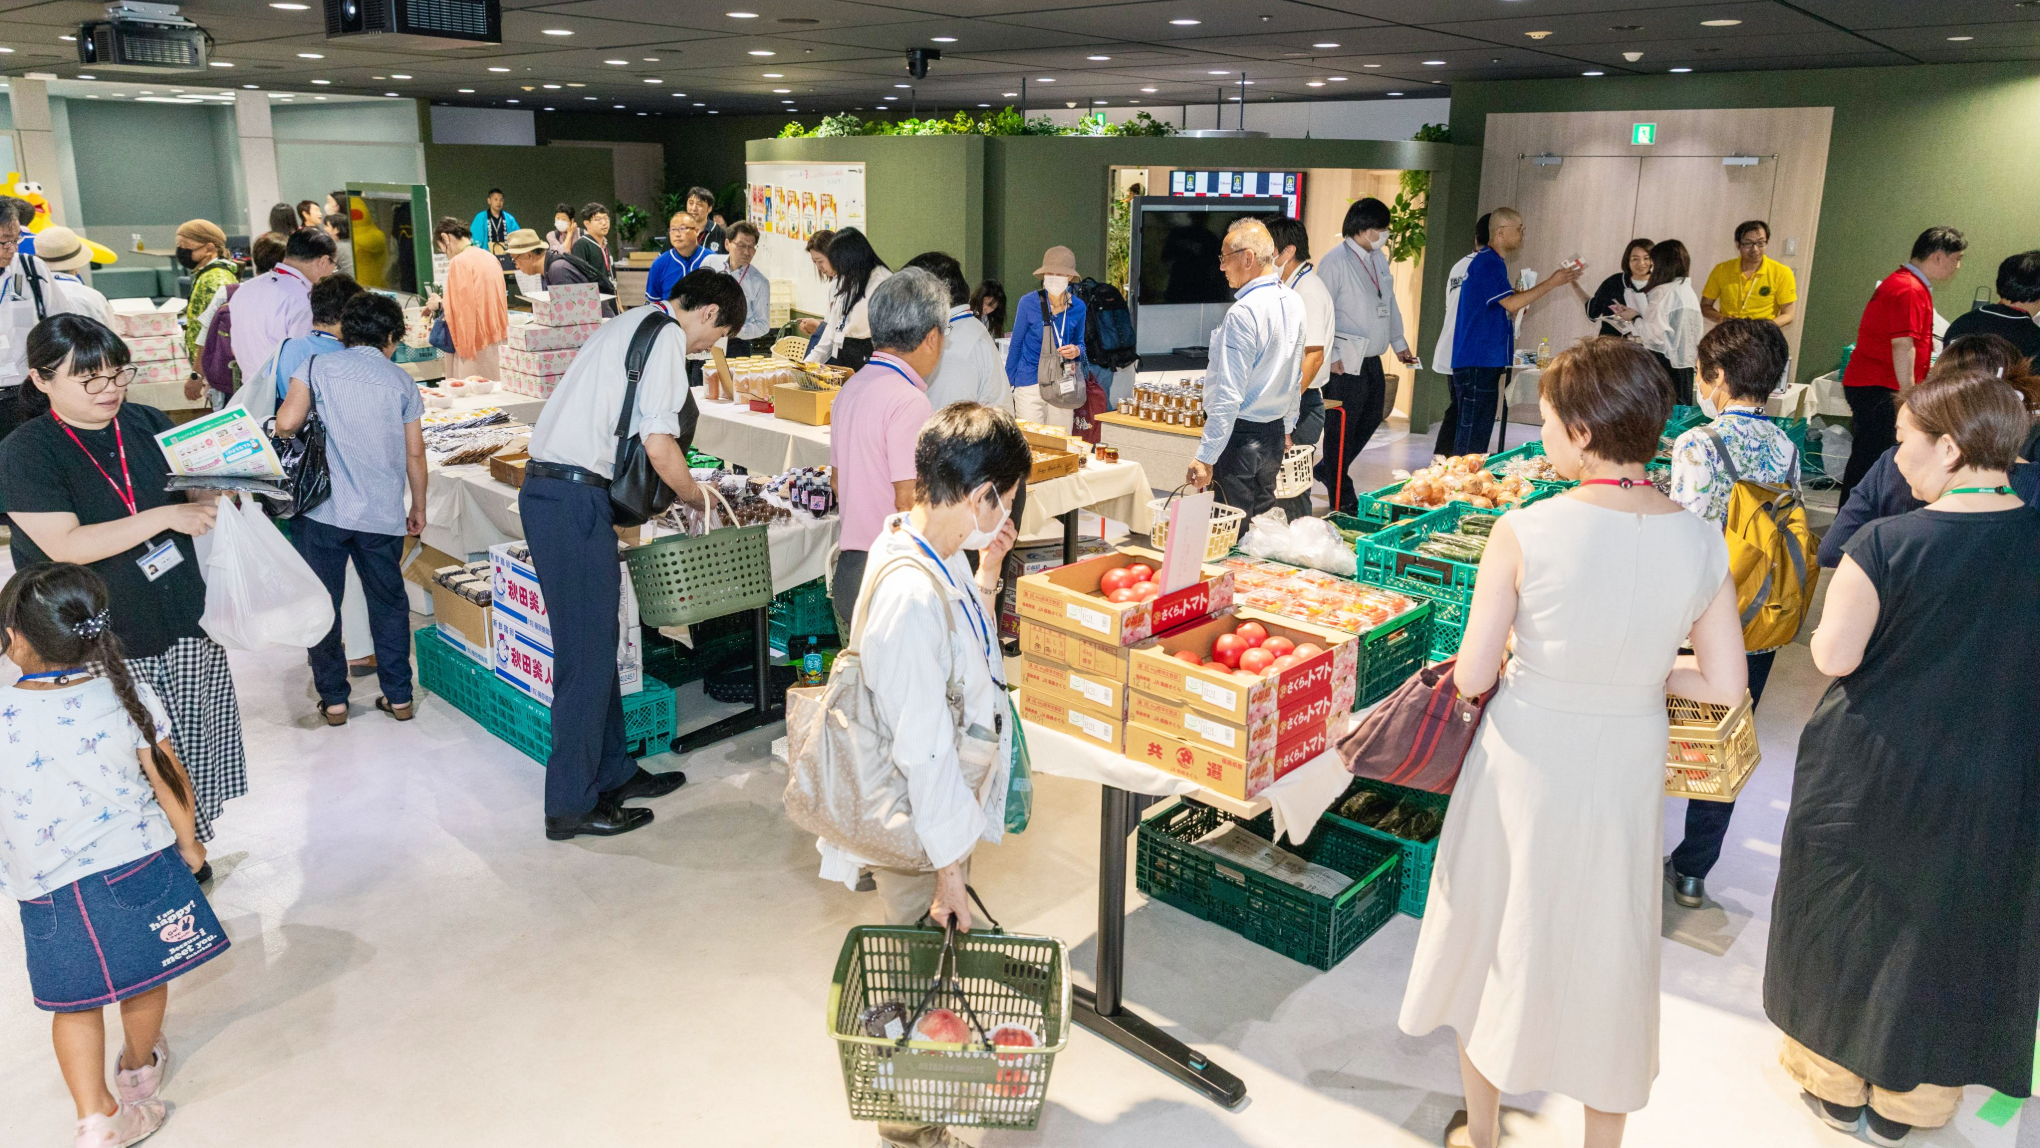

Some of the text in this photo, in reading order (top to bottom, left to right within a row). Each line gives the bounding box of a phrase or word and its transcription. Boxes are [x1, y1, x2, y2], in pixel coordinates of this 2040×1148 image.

[1161, 592, 1208, 621] さくらのトマト
[511, 647, 554, 686] 秋田美人
[1287, 661, 1332, 695] さくらのトマト
[1287, 696, 1331, 730] さくらのトマト
[1147, 741, 1223, 782] 共 選
[1283, 732, 1325, 768] さくらのトマト
[149, 899, 196, 932] happy!
[162, 908, 175, 919] am
[161, 934, 218, 968] meet you.
[168, 934, 201, 955] Because
